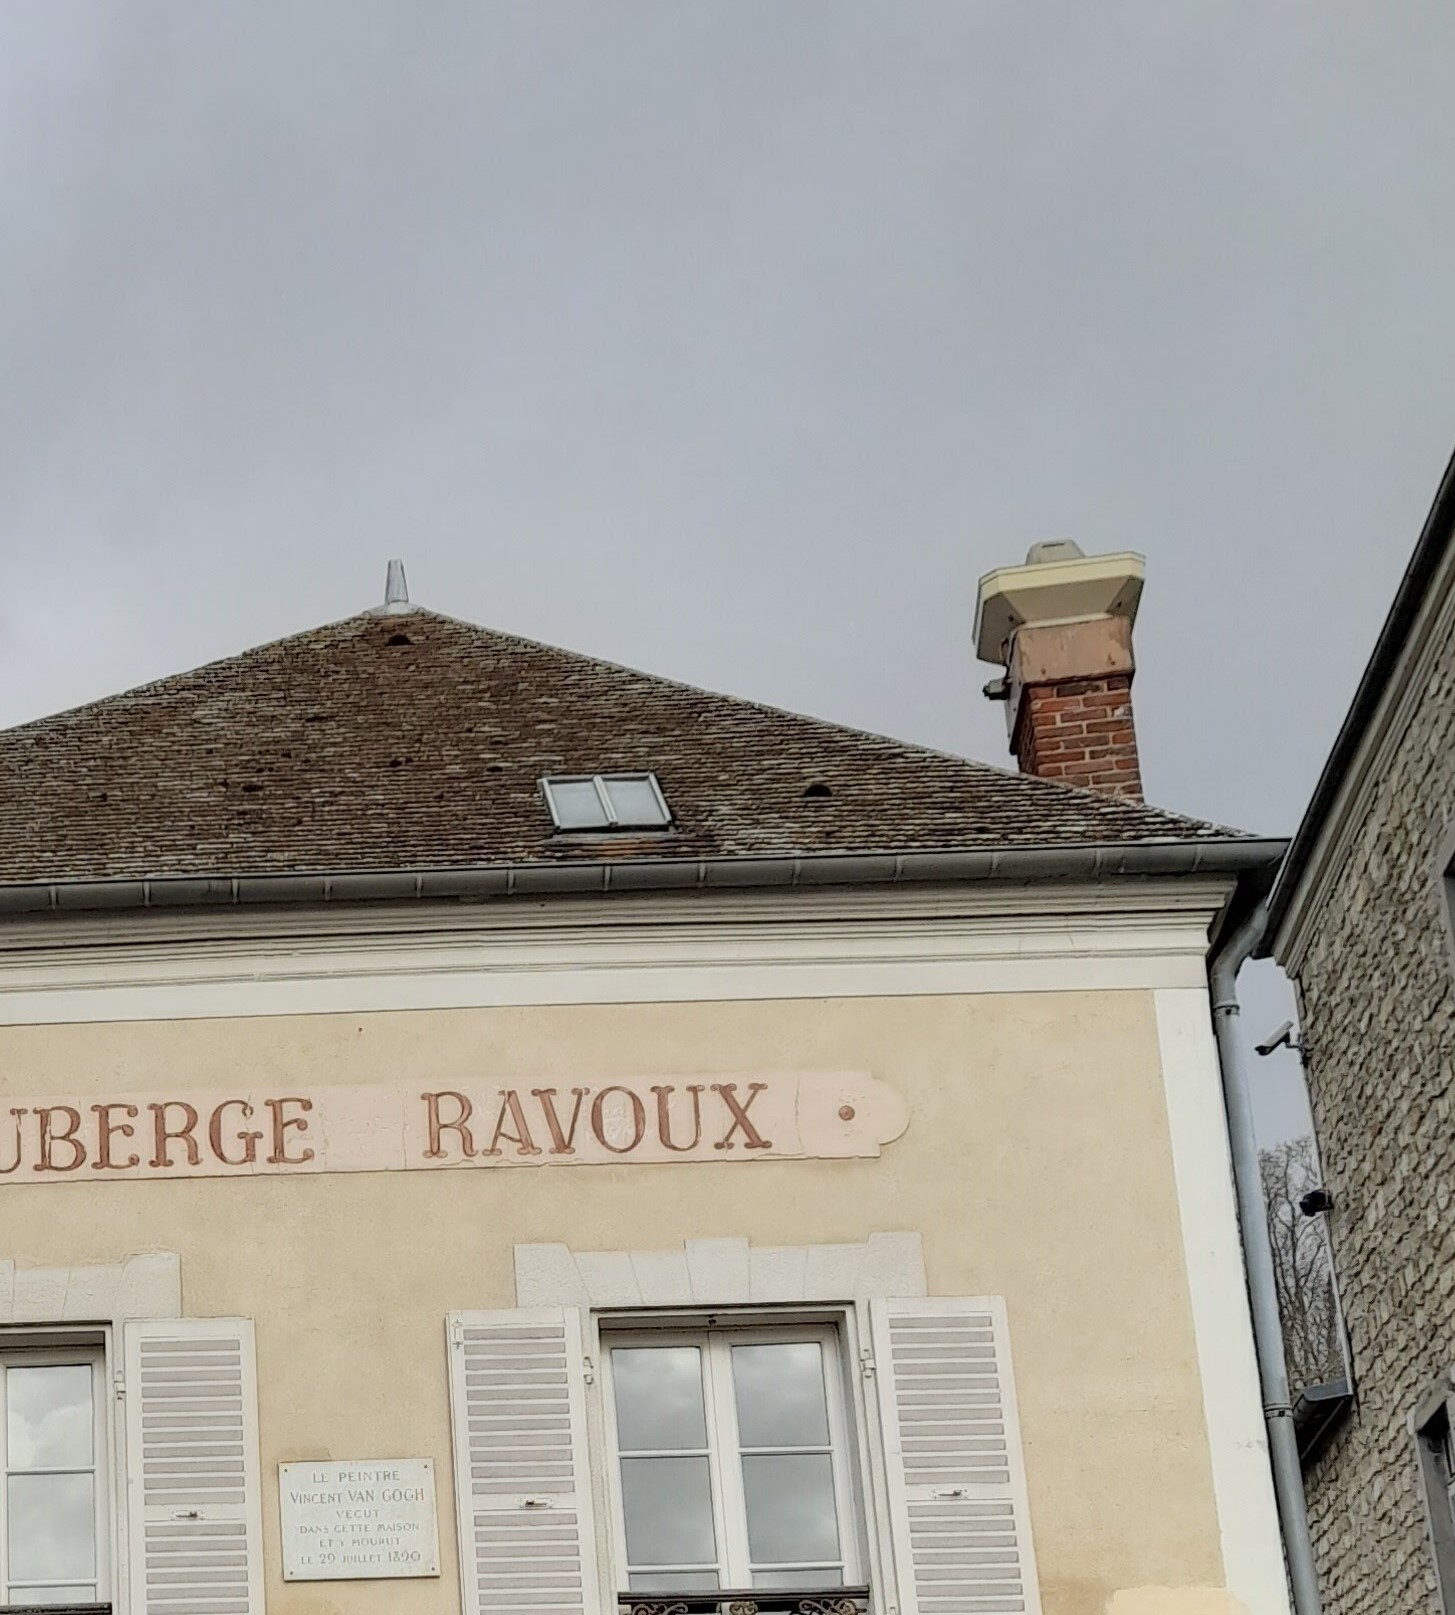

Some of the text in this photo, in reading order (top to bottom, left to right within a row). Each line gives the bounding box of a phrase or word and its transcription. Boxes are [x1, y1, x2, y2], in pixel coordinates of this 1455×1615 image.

[420, 1082, 774, 1160] RAVOUX
[313, 1471, 400, 1483] LE PEINTRE
[290, 1488, 424, 1504] VINCENT VAN GOGH
[300, 1523, 420, 1534] DANS CETTE MAISON
[320, 1539, 333, 1548] ET
[352, 1537, 401, 1546] MOURUT
[301, 1551, 421, 1565] LE 29 JUILLET 1890
